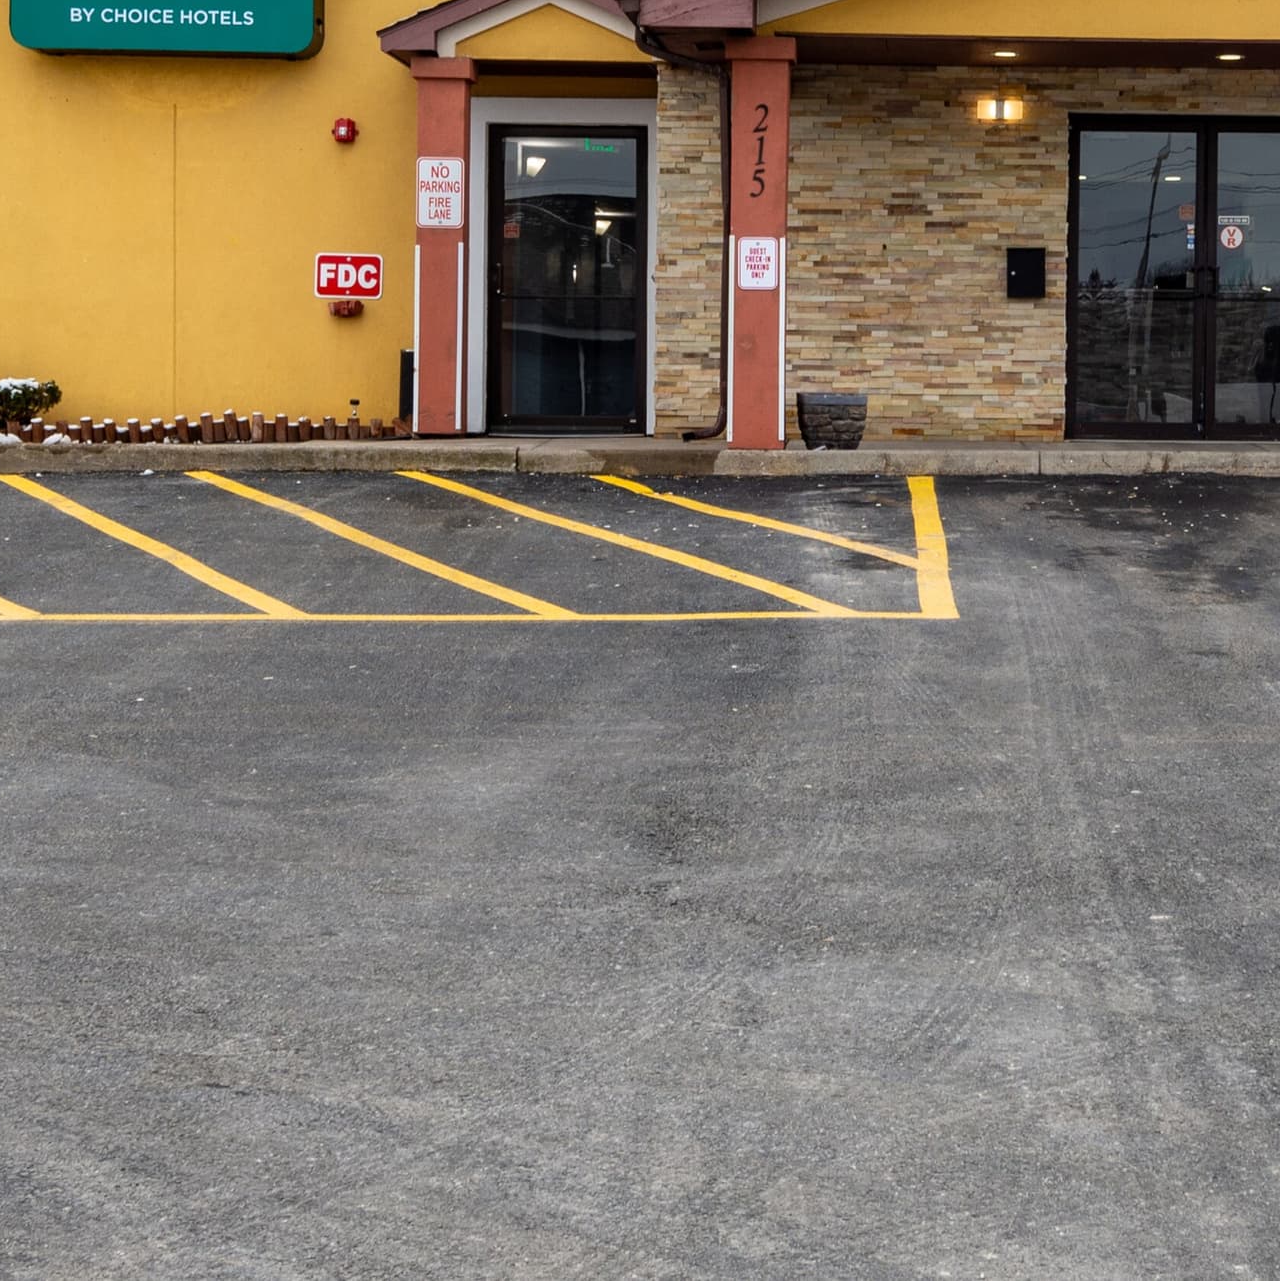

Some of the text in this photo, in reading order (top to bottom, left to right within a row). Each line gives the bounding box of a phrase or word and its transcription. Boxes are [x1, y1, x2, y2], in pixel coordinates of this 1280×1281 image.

[70, 7, 254, 26] BY CHOICE HOTELS
[430, 165, 450, 179] NO
[420, 180, 461, 194] PARKING
[428, 197, 452, 208] FIRE
[428, 209, 452, 220] LANE
[746, 263, 770, 271] PARKING
[320, 263, 378, 289] FDC
[751, 271, 765, 279] ONLY
